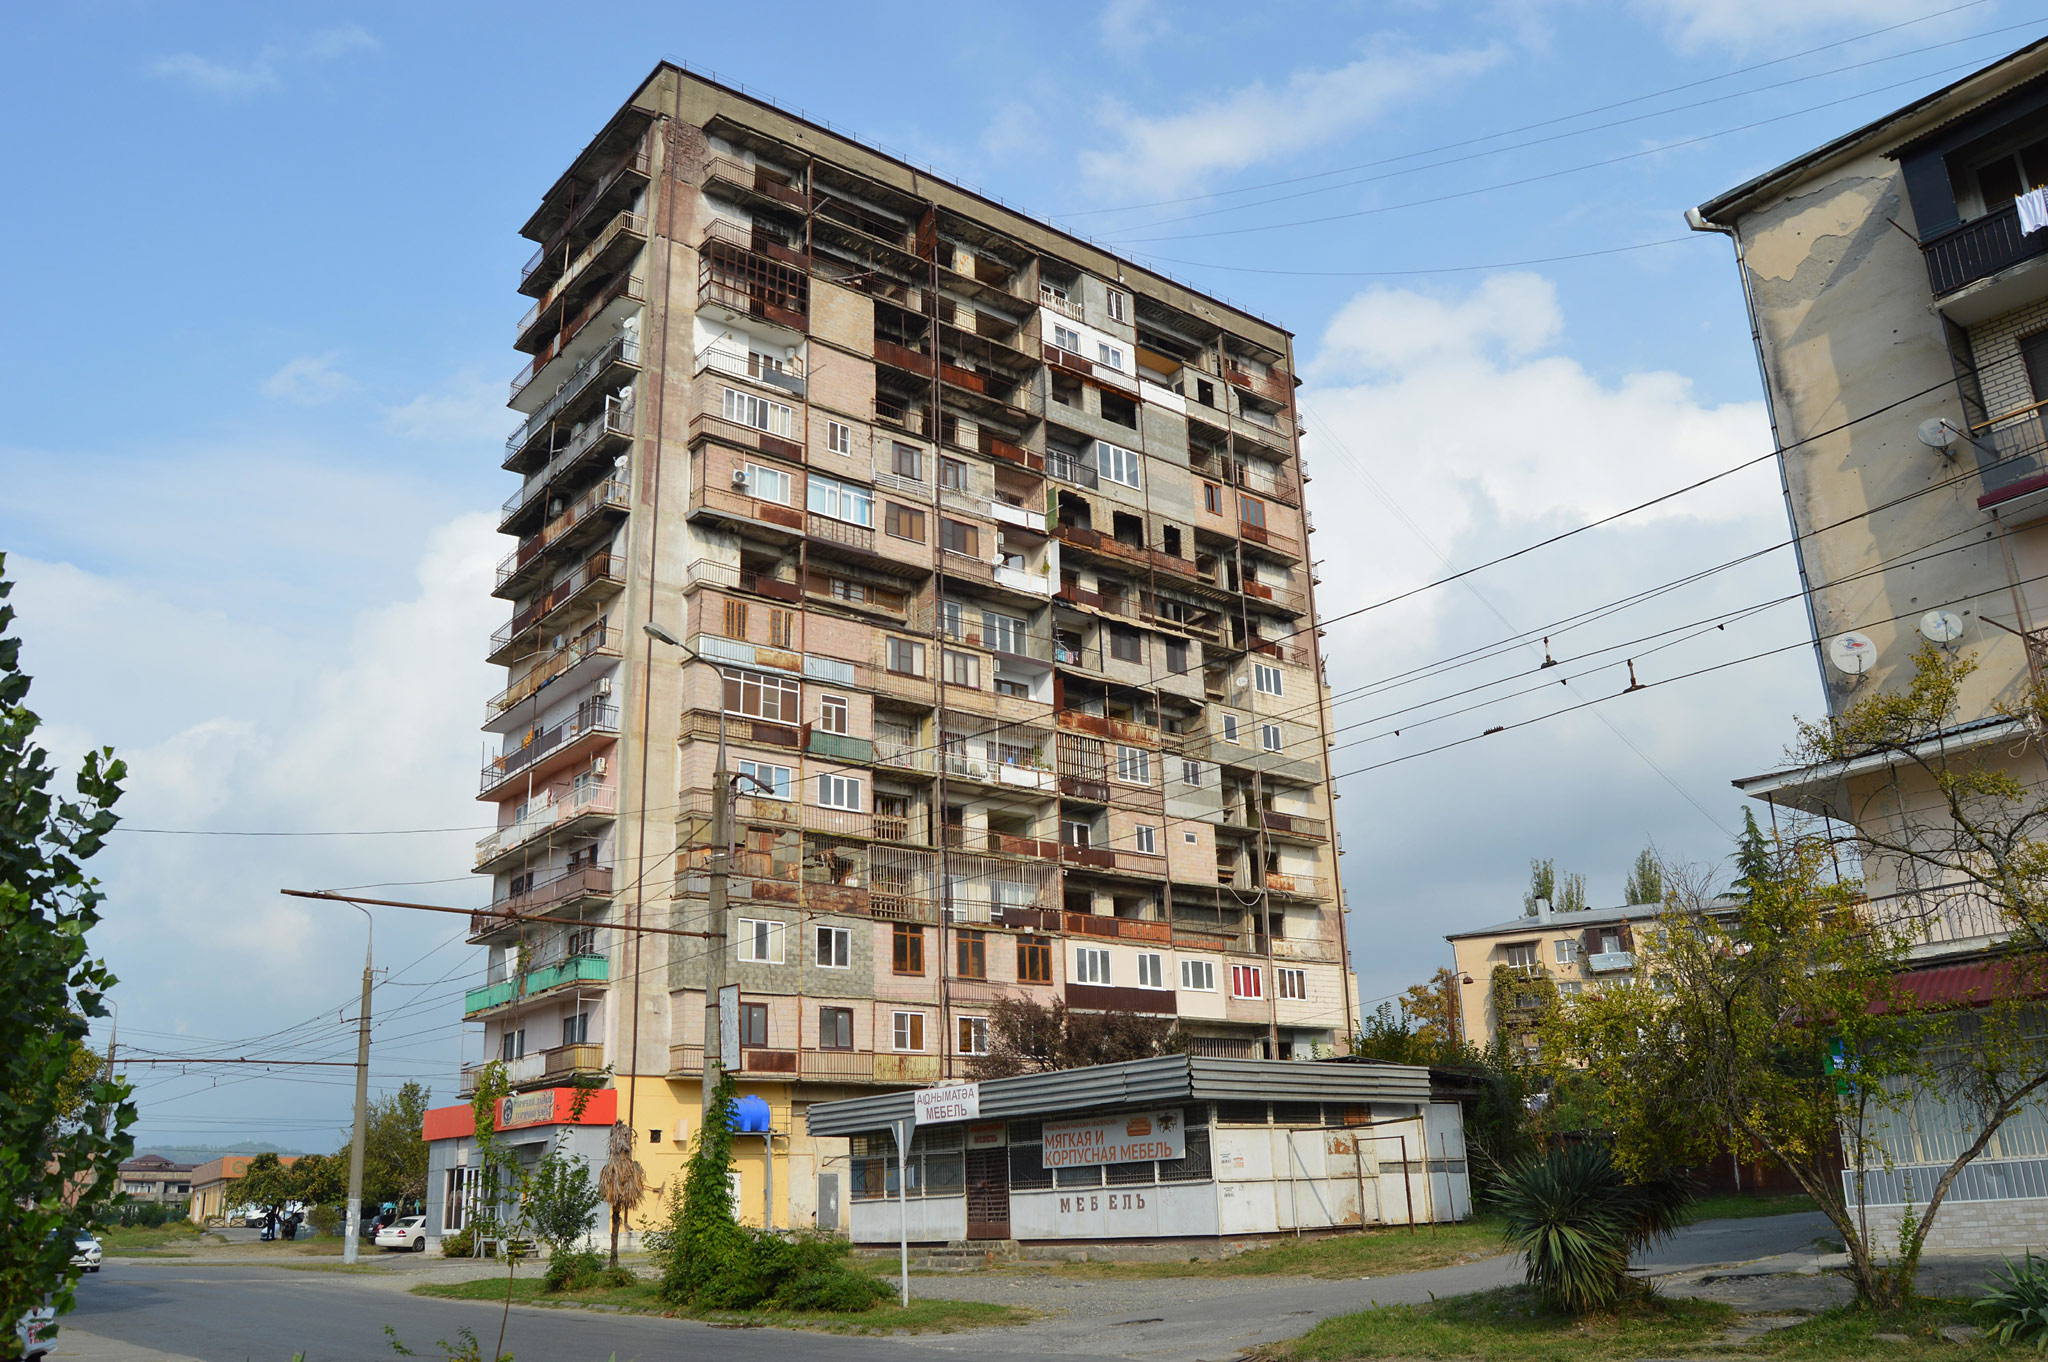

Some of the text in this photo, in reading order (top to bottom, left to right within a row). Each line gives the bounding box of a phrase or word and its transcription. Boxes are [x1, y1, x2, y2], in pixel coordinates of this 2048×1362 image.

[926, 1104, 967, 1120] МЕБЕЛЬ
[1044, 1129, 1104, 1150] МЯГКАЯ И
[1044, 1141, 1173, 1166] КОРПУСНАЯ МЕБЕЛЬ
[1060, 1193, 1146, 1213] МЕБЕЛЬ
